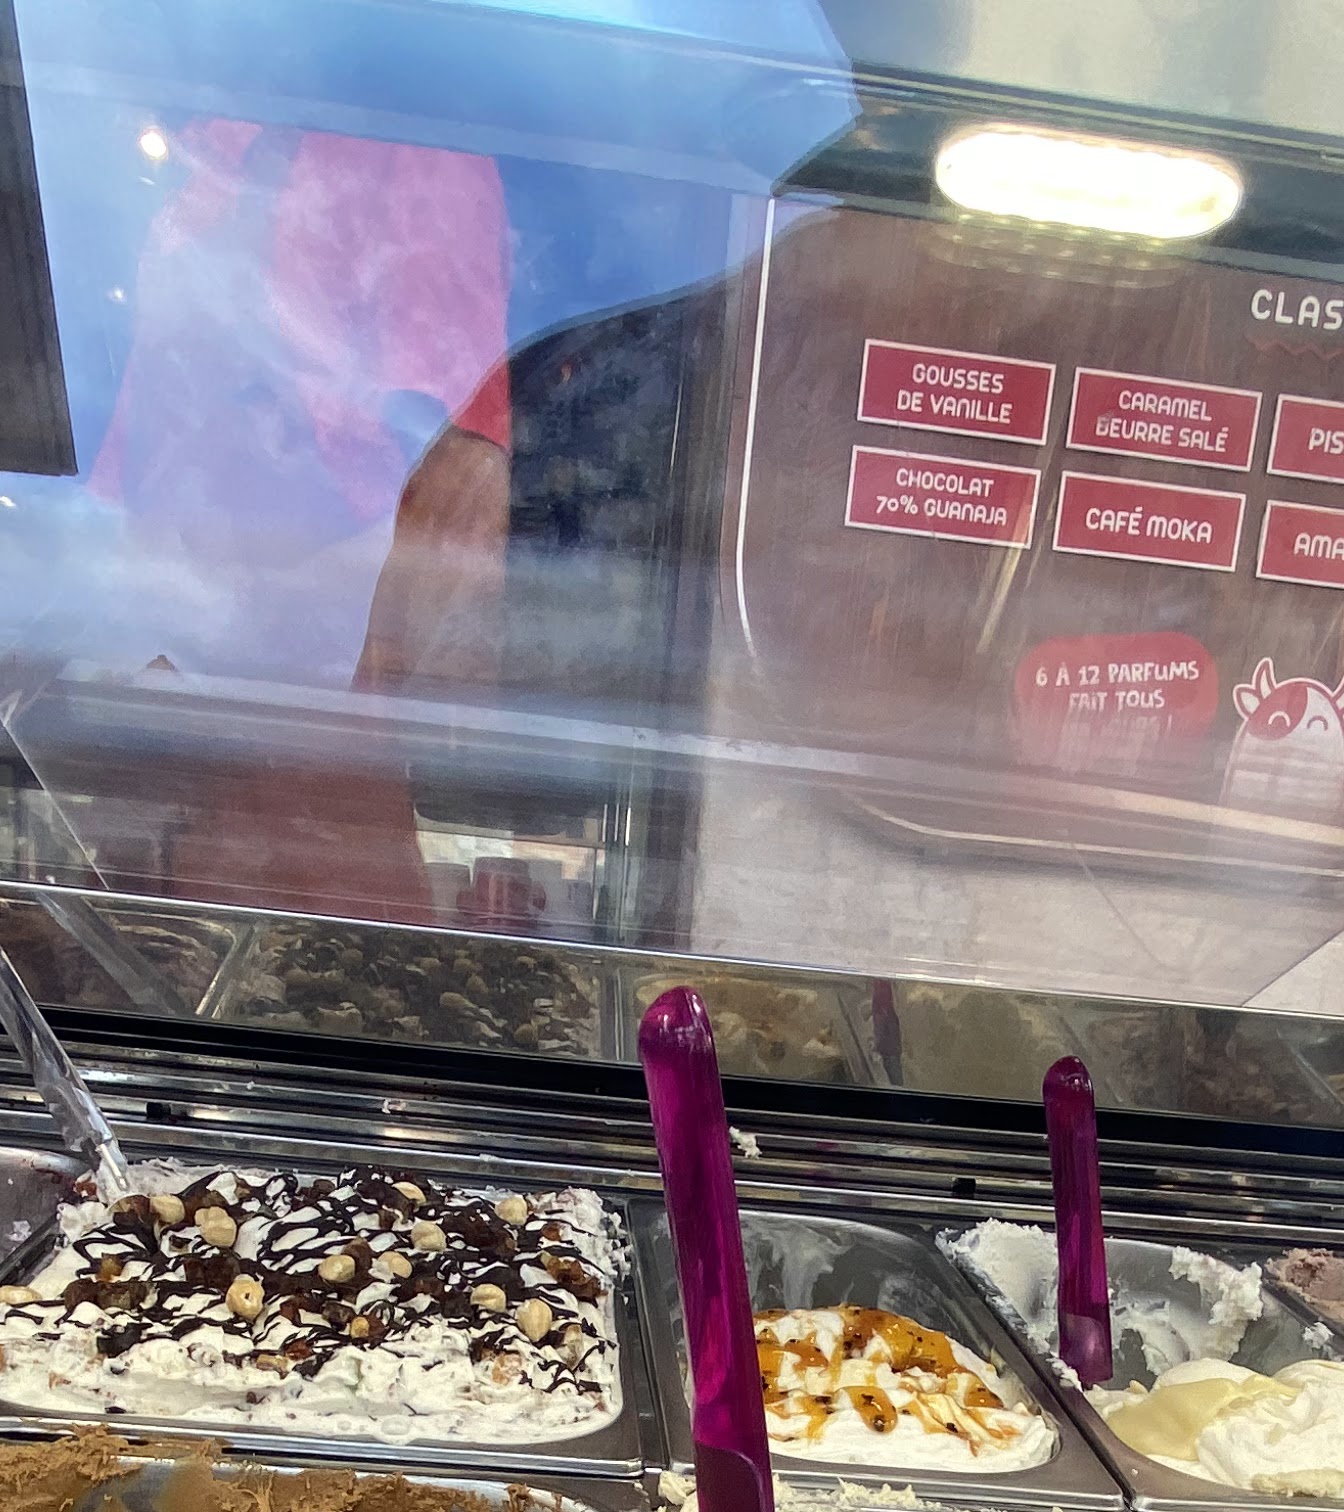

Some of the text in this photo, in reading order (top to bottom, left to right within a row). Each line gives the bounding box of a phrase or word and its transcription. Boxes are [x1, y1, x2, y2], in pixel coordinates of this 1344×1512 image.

[912, 363, 1004, 394] GOUSSES
[897, 389, 1013, 424] DE VANILLE
[1118, 390, 1212, 422] CARAMEL
[1095, 416, 1229, 453] BEURRE SALÉ
[896, 468, 994, 498] CHOCOLAT
[875, 494, 1007, 526] 70% GUANAJA
[1085, 506, 1213, 544] CAFÉ MOKA
[1035, 666, 1048, 687] 6
[1078, 665, 1100, 686] 12
[1108, 661, 1200, 683] PARFUMS
[1115, 689, 1166, 711] TOUS
